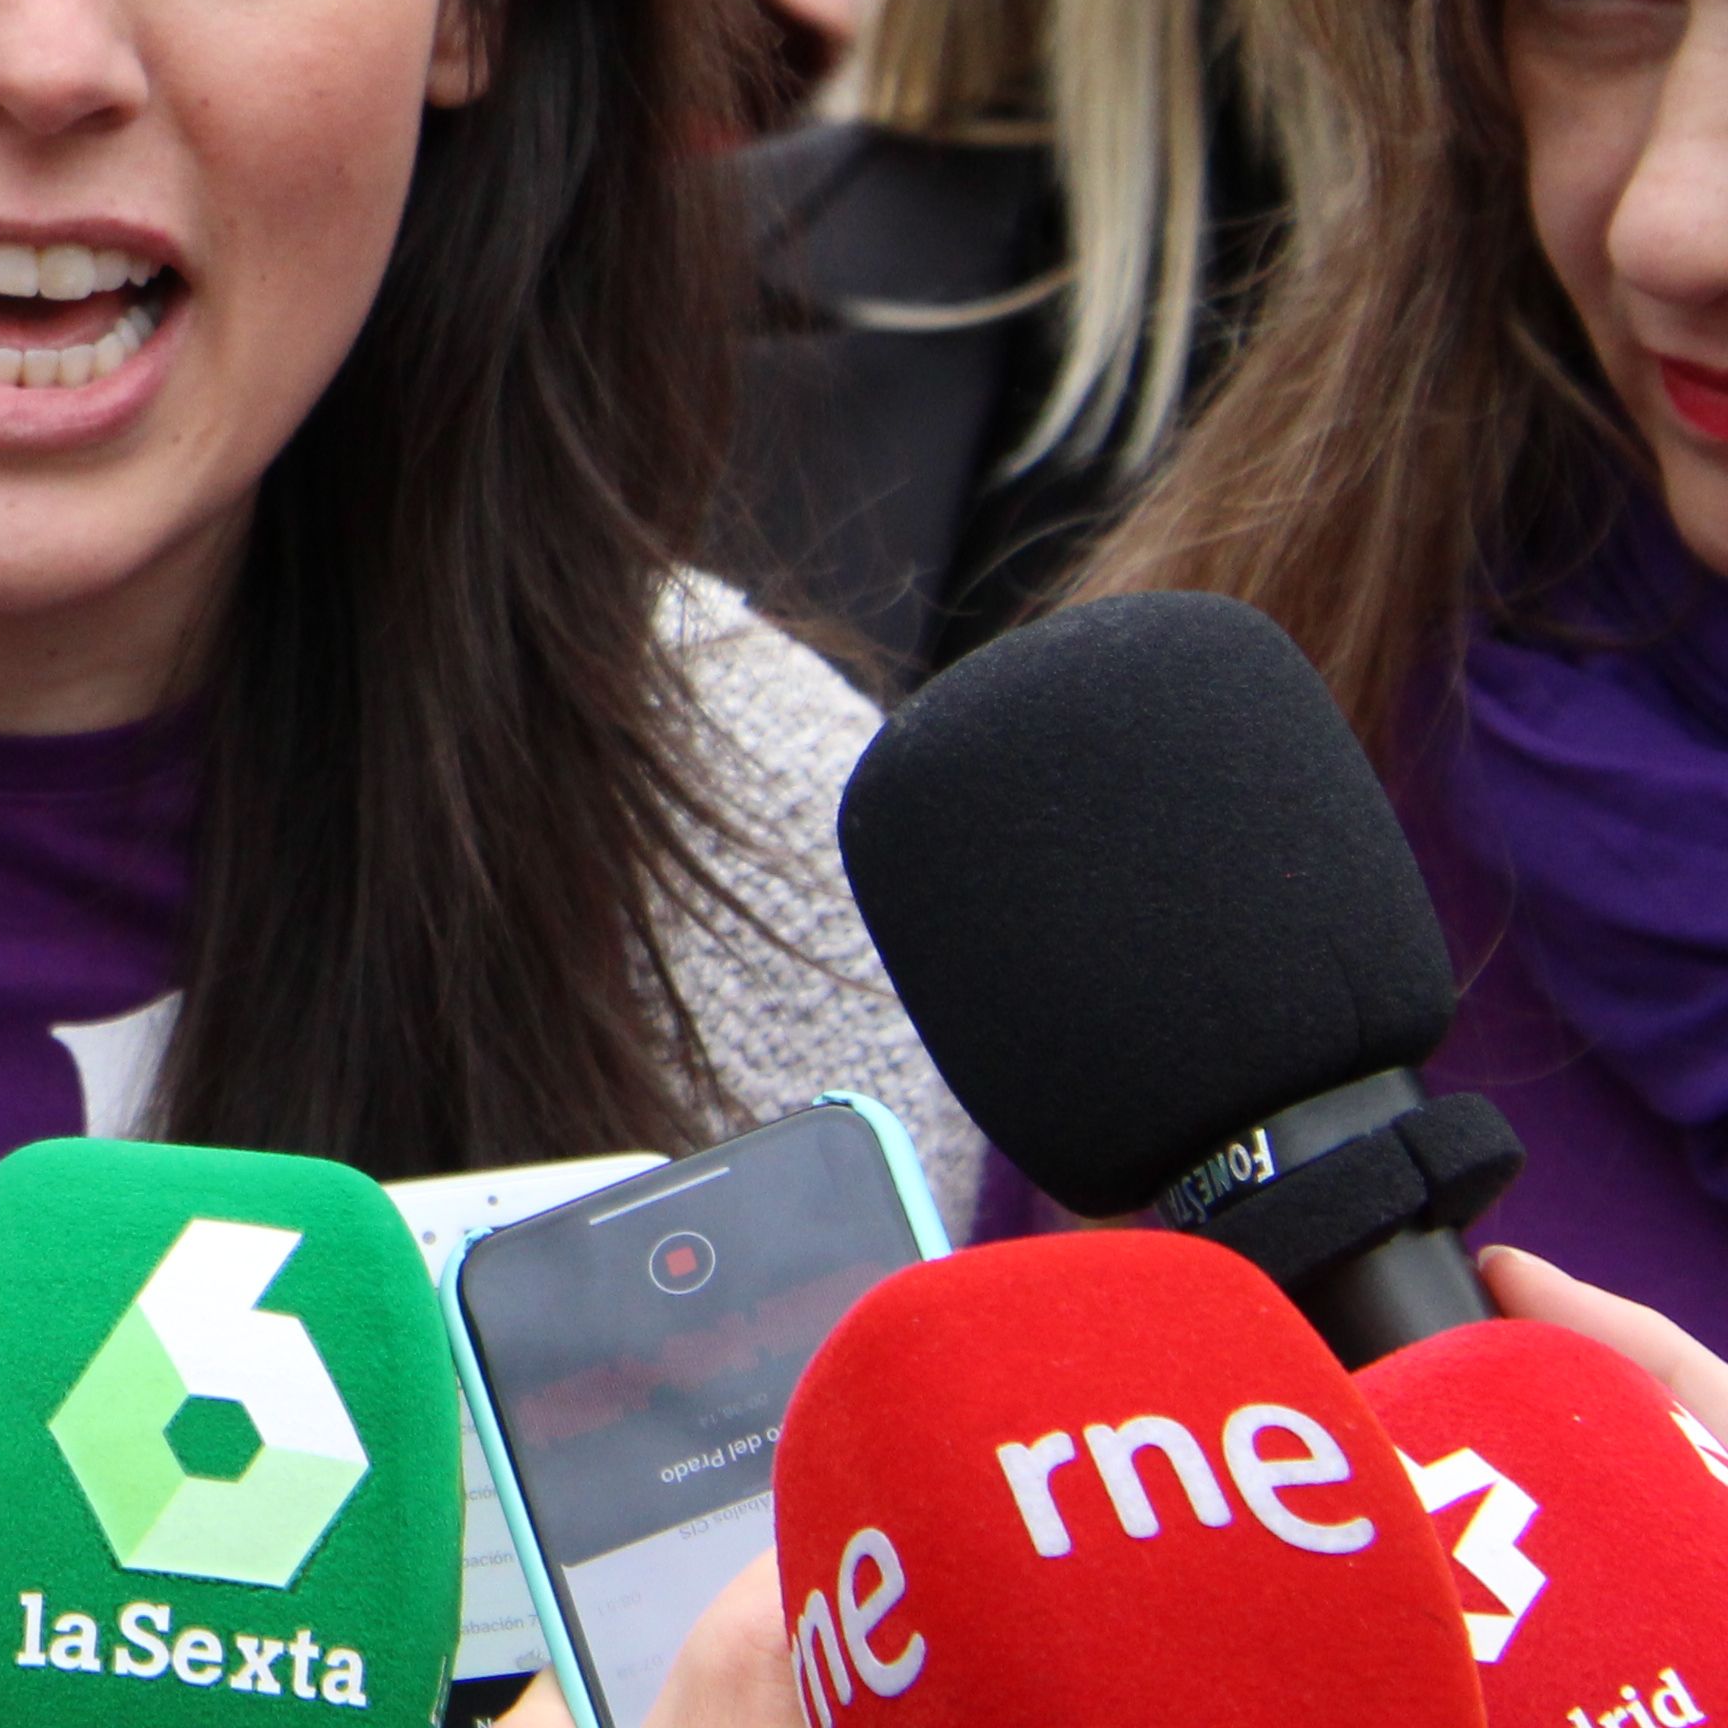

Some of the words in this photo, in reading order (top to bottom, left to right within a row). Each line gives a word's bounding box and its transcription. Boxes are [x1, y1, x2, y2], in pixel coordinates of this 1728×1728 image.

[727, 1429, 763, 1462] del
[659, 1446, 726, 1485] Prado
[995, 1403, 1376, 1558] rne
